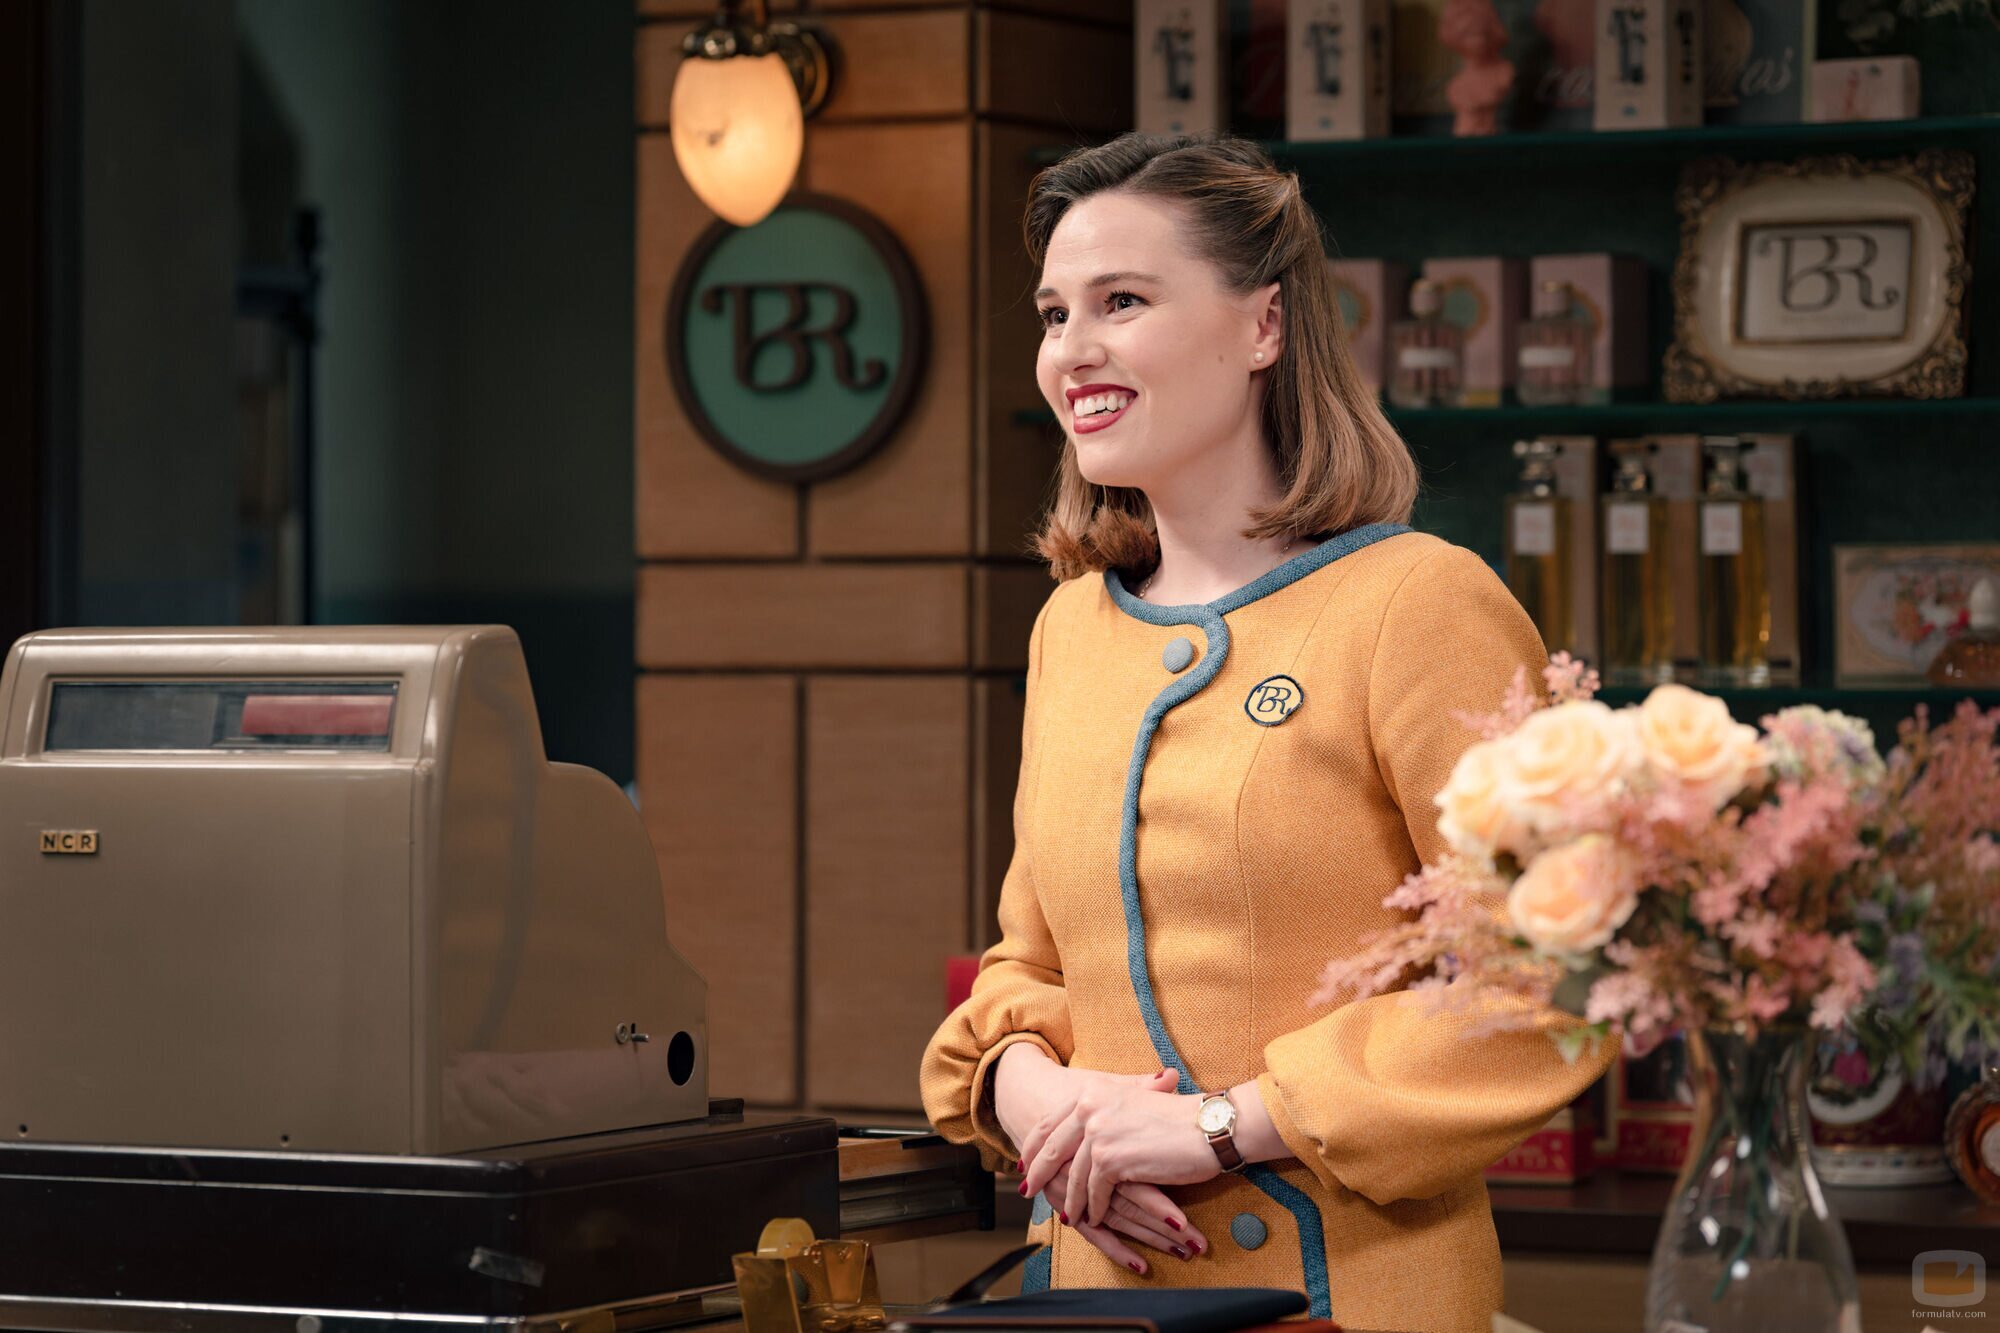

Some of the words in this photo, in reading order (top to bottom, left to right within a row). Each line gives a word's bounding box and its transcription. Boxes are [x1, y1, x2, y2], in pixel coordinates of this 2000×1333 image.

[1757, 232, 1900, 312] BR
[702, 283, 888, 394] BR
[1257, 686, 1291, 715] BR
[43, 834, 92, 849] NCR
